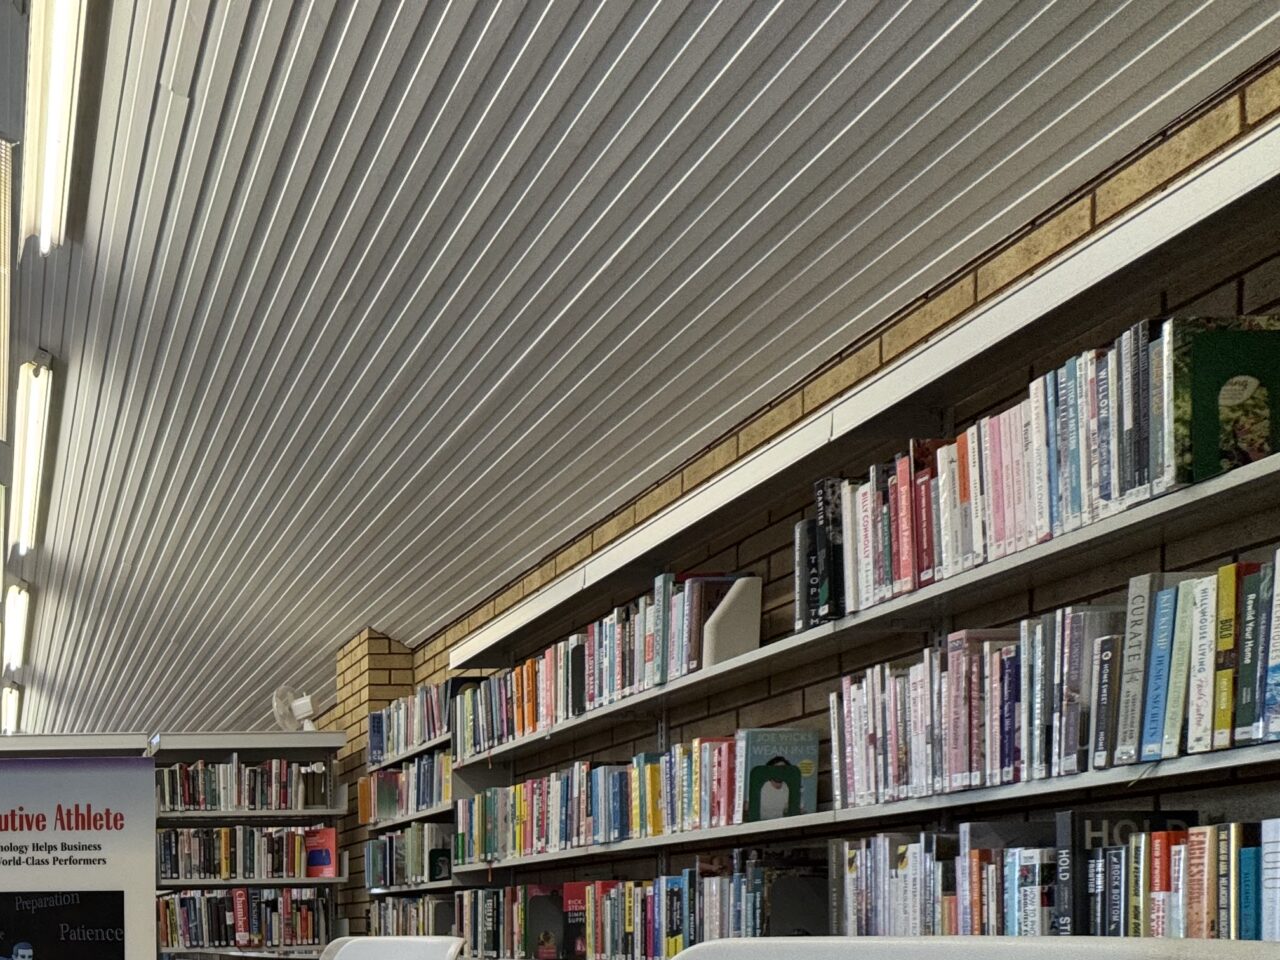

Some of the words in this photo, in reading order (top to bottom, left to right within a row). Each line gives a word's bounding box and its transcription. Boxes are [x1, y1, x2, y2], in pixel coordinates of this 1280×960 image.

[1099, 368, 1109, 417] WILLOW
[816, 489, 824, 526] CARTIER
[861, 491, 870, 512] BILLY
[862, 514, 870, 560] CONNOLLY
[1245, 593, 1256, 621] Rewild
[1127, 594, 1146, 664] CURATE
[1220, 618, 1233, 639] BOLD
[1244, 621, 1255, 640] Your
[1243, 640, 1254, 664] Home
[55, 803, 125, 831] Athlete
[32, 842, 58, 855] Helps
[61, 841, 102, 852] Business
[52, 855, 107, 867] Performers
[1153, 839, 1161, 857] DAVID
[1058, 849, 1070, 880] HOLD
[1111, 864, 1120, 886] ROCK
[1153, 858, 1161, 892] HEPWORTH
[15, 892, 80, 913] Preparation
[235, 890, 247, 933] Chamber
[1111, 888, 1120, 921] BOTTOM
[59, 923, 124, 942] Patience
